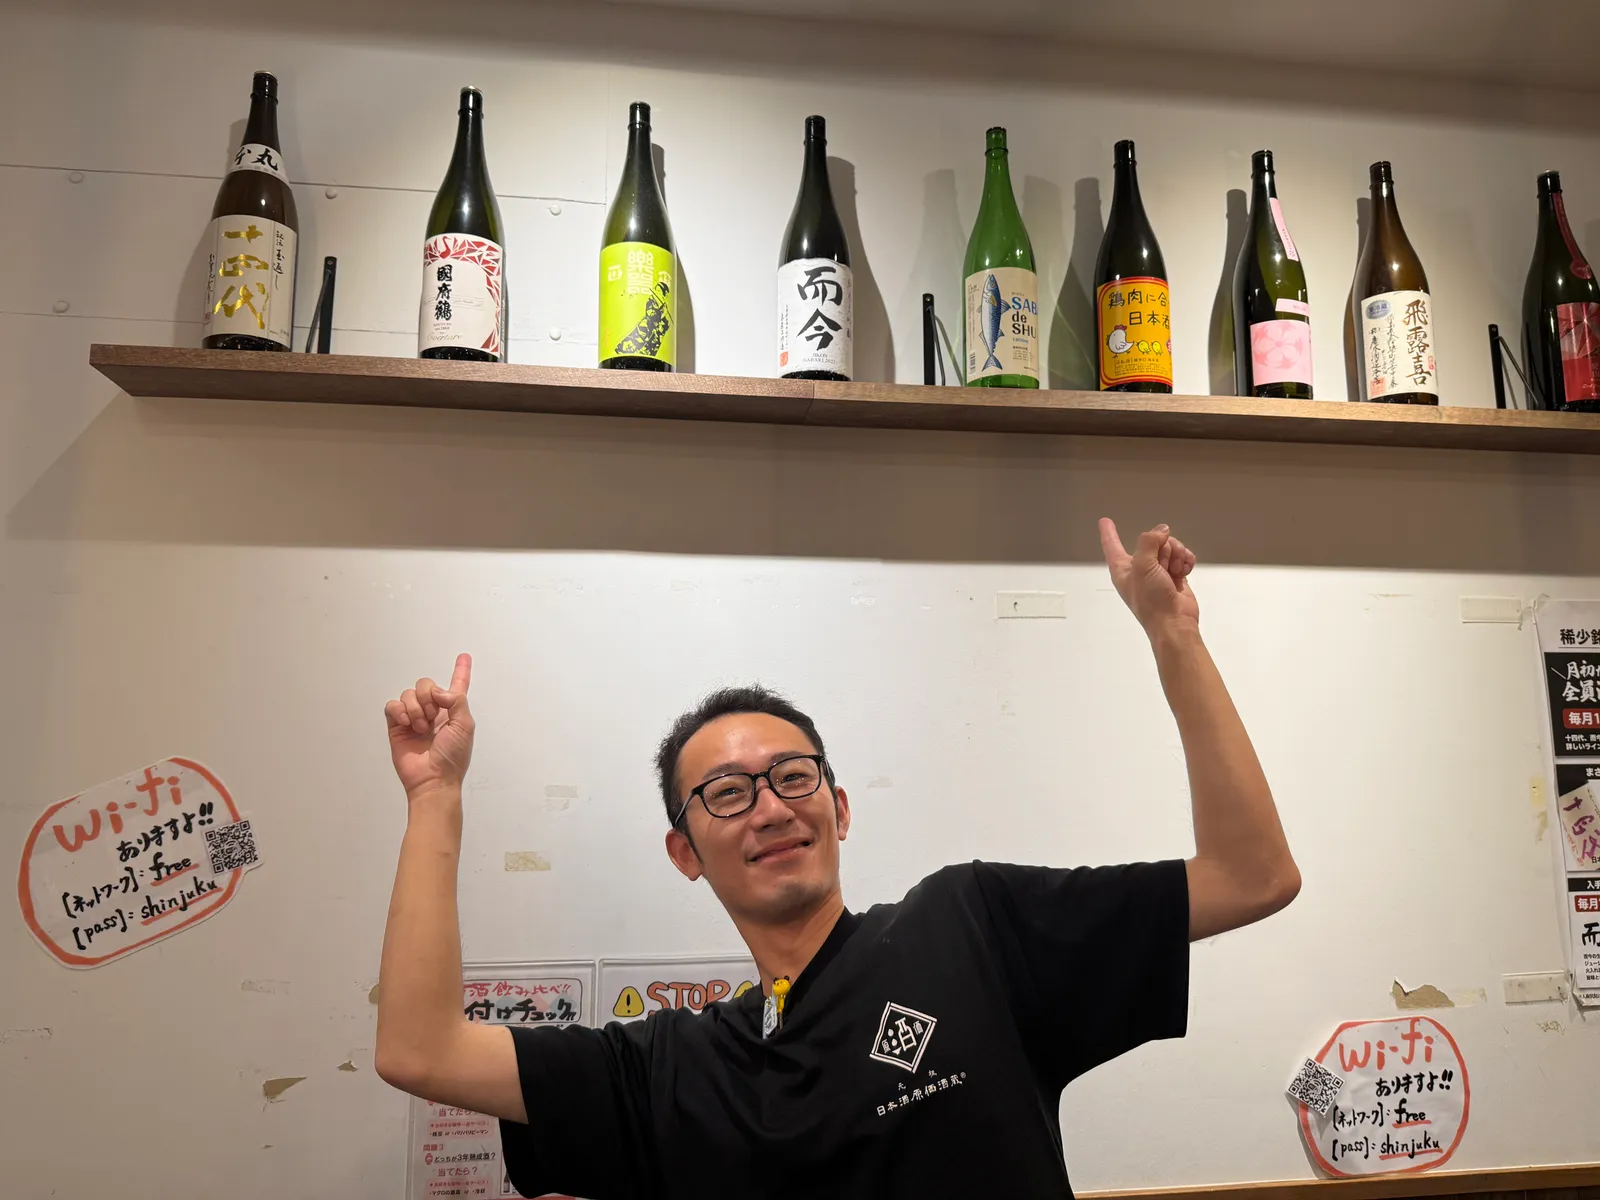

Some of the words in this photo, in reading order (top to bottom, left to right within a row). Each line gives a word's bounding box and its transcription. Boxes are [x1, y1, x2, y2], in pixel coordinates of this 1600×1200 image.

[796, 266, 844, 351] 而今
[1011, 296, 1038, 316] SAB
[1108, 289, 1170, 309] 鶏肉に合
[1012, 312, 1027, 323] de
[1129, 311, 1170, 329] 日本酒
[1012, 323, 1037, 339] SHU
[1402, 299, 1432, 386] 飛露喜
[149, 851, 192, 881] free
[140, 876, 219, 919] shinjuku
[1577, 897, 1600, 910] 毎月
[647, 979, 732, 1010] STOP
[1394, 1098, 1426, 1124] free
[1380, 1130, 1441, 1158] shinjuku
